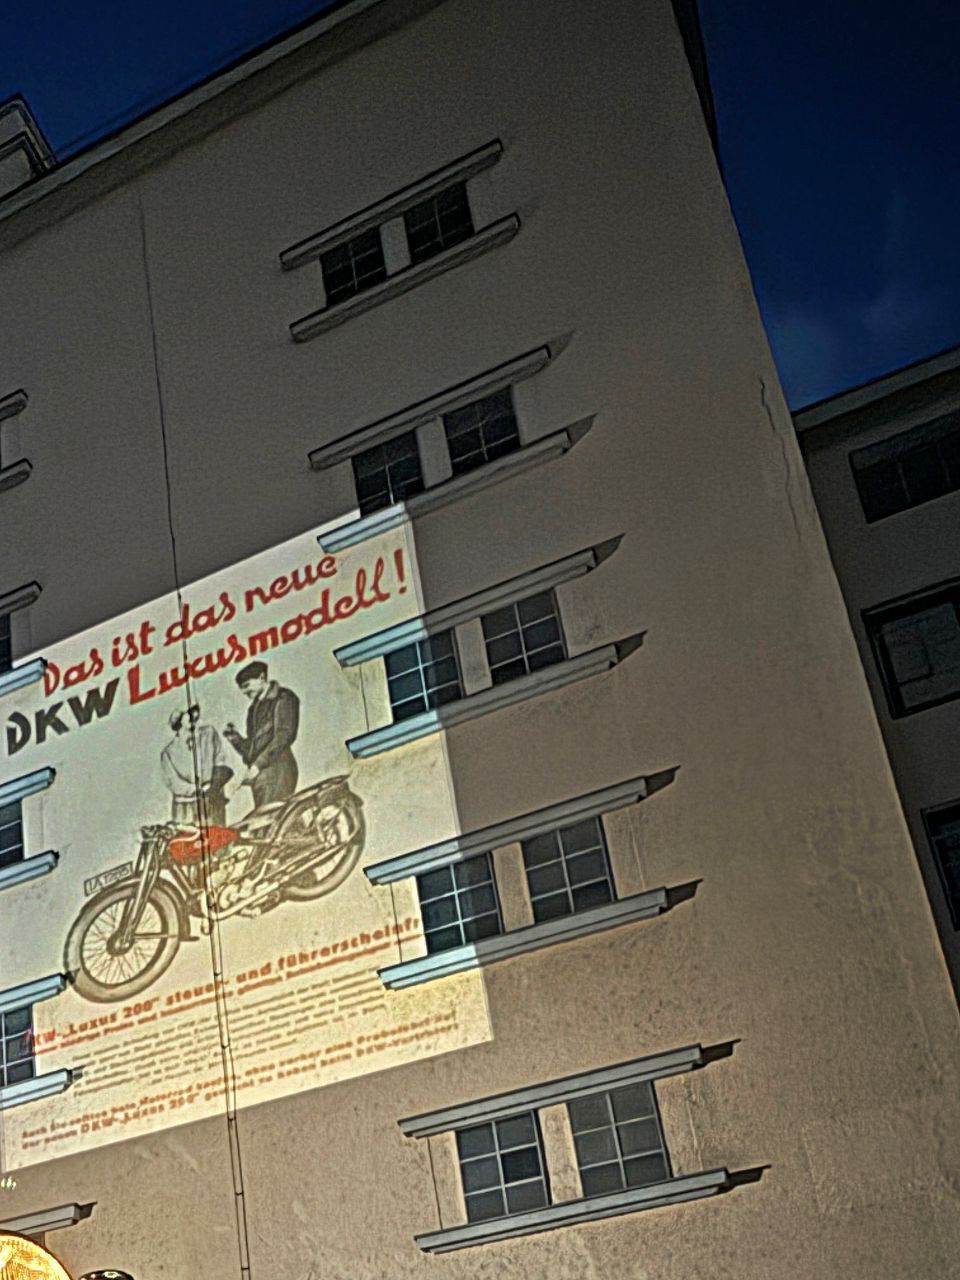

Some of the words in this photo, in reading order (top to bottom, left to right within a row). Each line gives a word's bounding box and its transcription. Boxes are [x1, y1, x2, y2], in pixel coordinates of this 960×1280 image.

[6, 677, 120, 756] DKW
[128, 548, 407, 707] Luxusmodell!
[43, 648, 103, 698] Das
[112, 622, 156, 667] ist
[163, 592, 237, 647] das
[244, 555, 338, 613] neue
[236, 962, 271, 983] und
